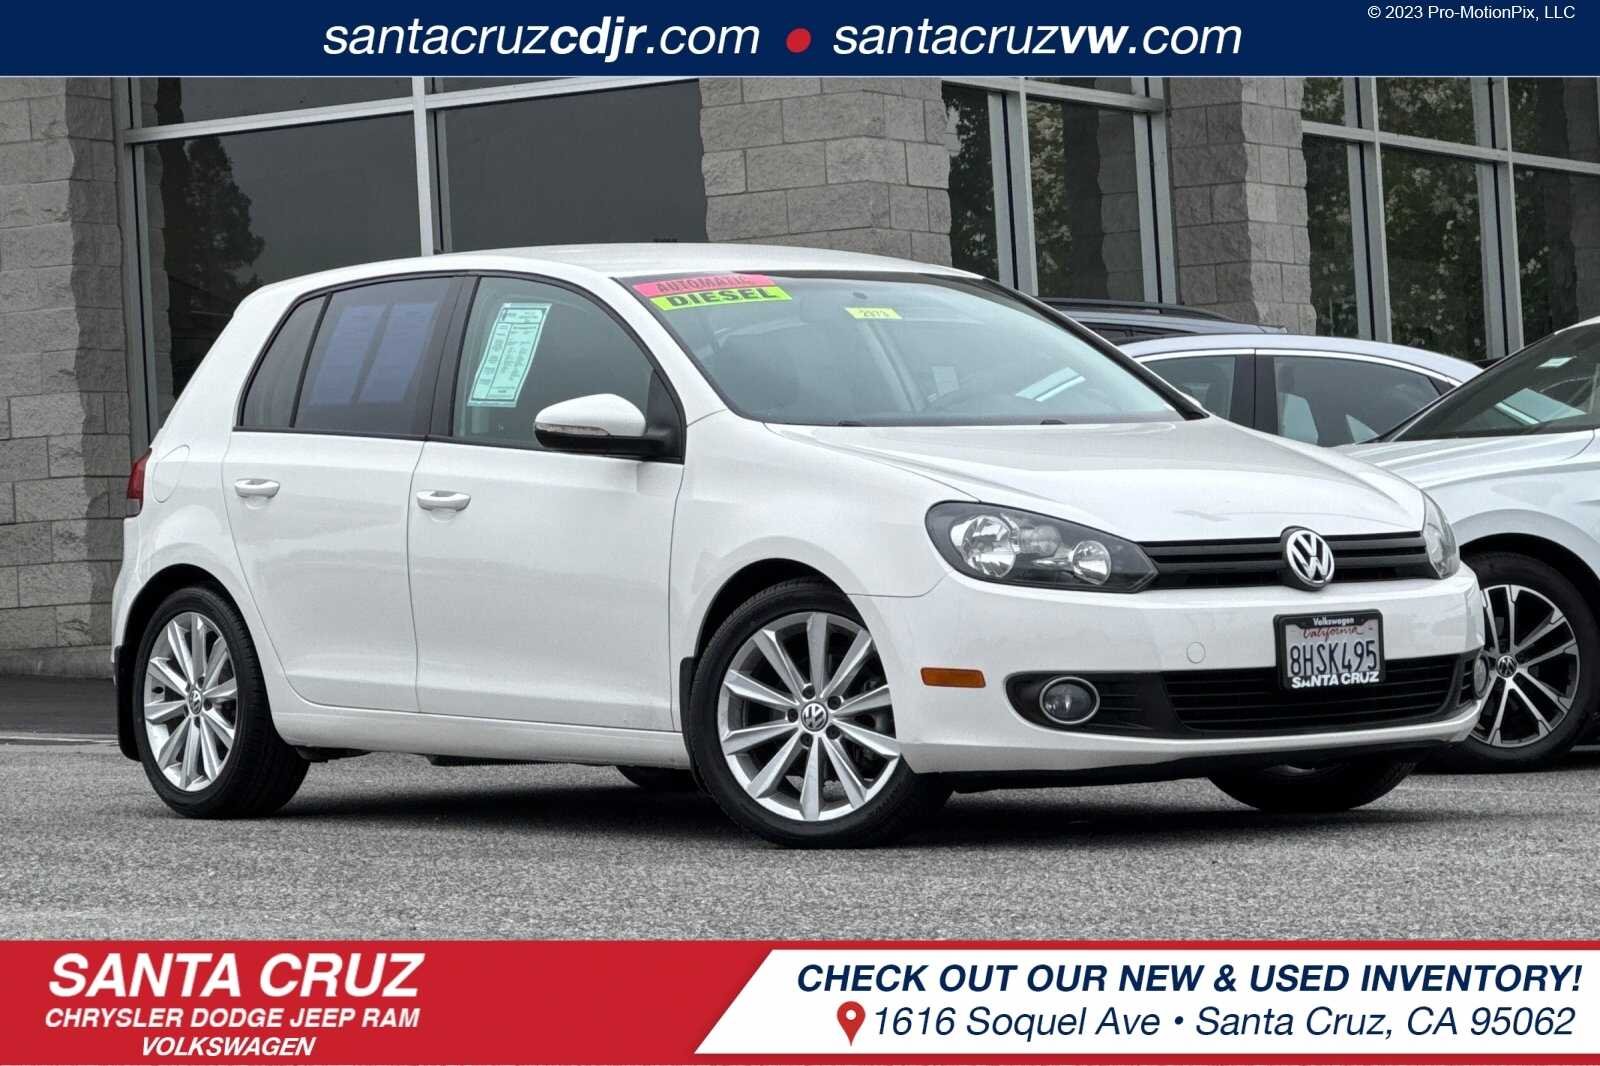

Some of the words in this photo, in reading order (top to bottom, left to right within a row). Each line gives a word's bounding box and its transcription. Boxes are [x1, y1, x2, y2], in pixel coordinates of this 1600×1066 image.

[656, 275, 750, 293] AUTOMATIC
[665, 287, 777, 307] DIESEL
[1312, 615, 1355, 626] Volkswagen
[1303, 626, 1364, 641] California
[1290, 640, 1377, 676] 8HSK495
[1341, 671, 1380, 685] CRUZ
